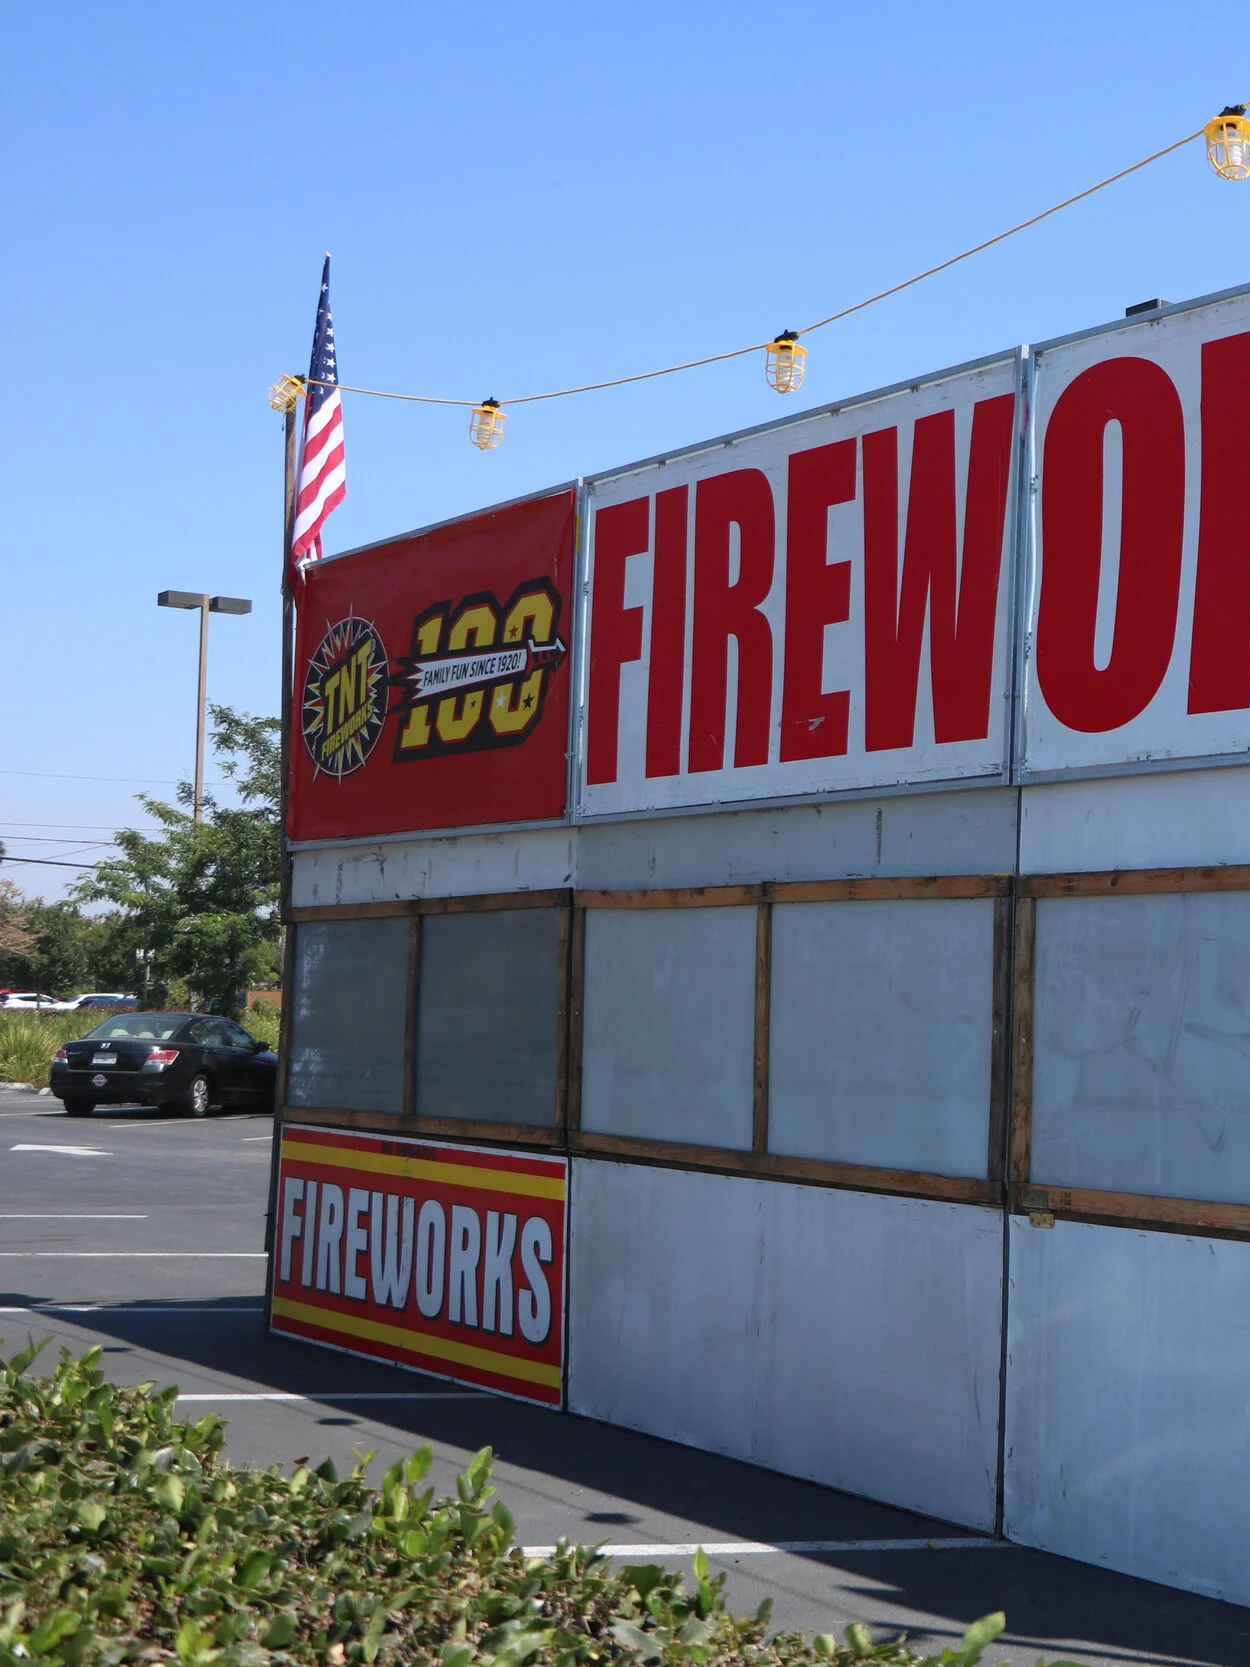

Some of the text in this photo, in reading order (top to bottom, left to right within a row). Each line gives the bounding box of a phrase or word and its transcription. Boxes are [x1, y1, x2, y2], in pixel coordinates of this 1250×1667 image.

[324, 638, 373, 735] TNT
[400, 592, 554, 748] 100
[423, 652, 522, 687] FAMILY FUN SINCE 1920!
[321, 696, 375, 761] FIREWORKS
[279, 1176, 553, 1345] FIREWORKS
